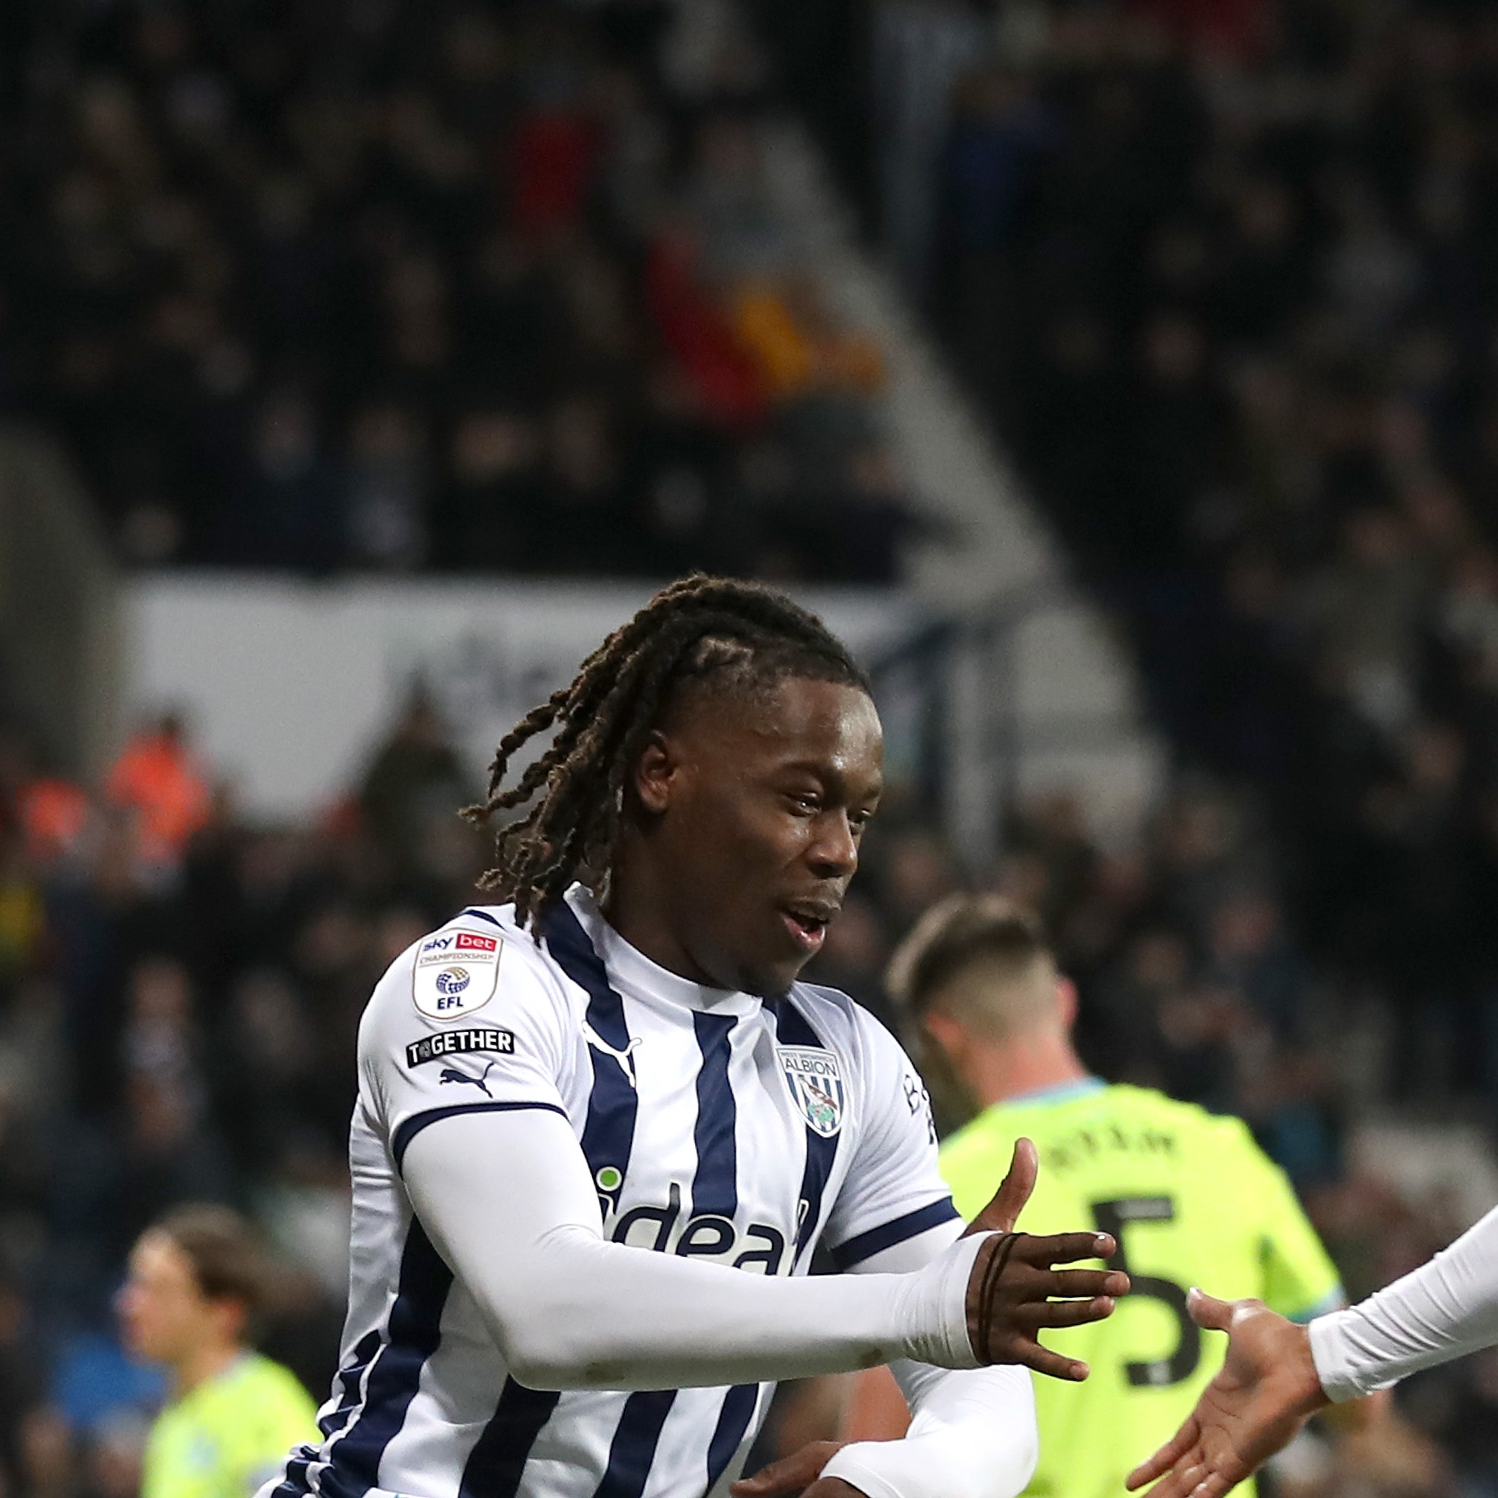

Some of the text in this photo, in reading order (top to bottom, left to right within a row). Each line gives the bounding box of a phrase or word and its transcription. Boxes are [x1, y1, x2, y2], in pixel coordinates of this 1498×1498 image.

[424, 934, 493, 951] sky bet
[437, 996, 464, 1010] EFL
[786, 1058, 837, 1077] ALBION
[1091, 1195, 1201, 1387] 5
